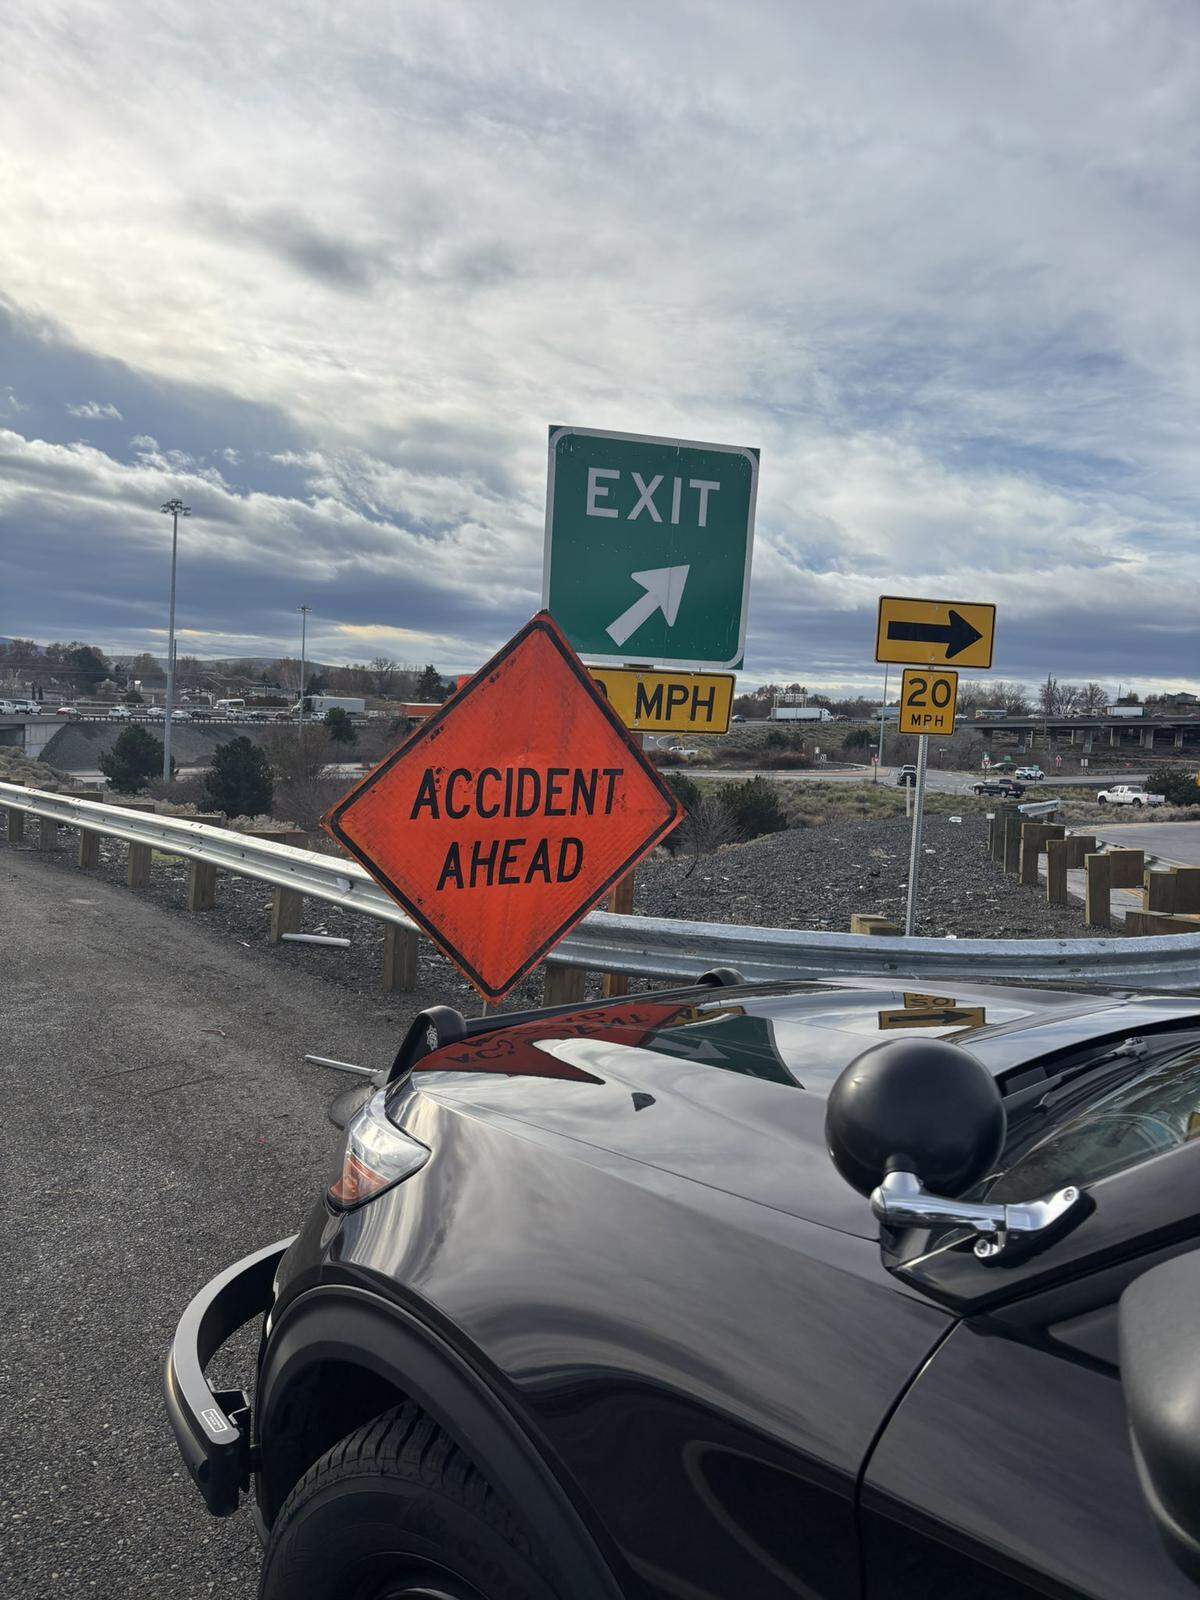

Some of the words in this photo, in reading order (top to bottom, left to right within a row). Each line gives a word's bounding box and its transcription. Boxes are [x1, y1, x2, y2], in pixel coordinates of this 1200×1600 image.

[586, 467, 720, 527] EXIT
[635, 682, 716, 722] MPH
[907, 678, 951, 708] 20
[911, 713, 944, 727] MPH
[409, 767, 624, 820] ACCIDENT
[436, 837, 584, 891] AHEAD
